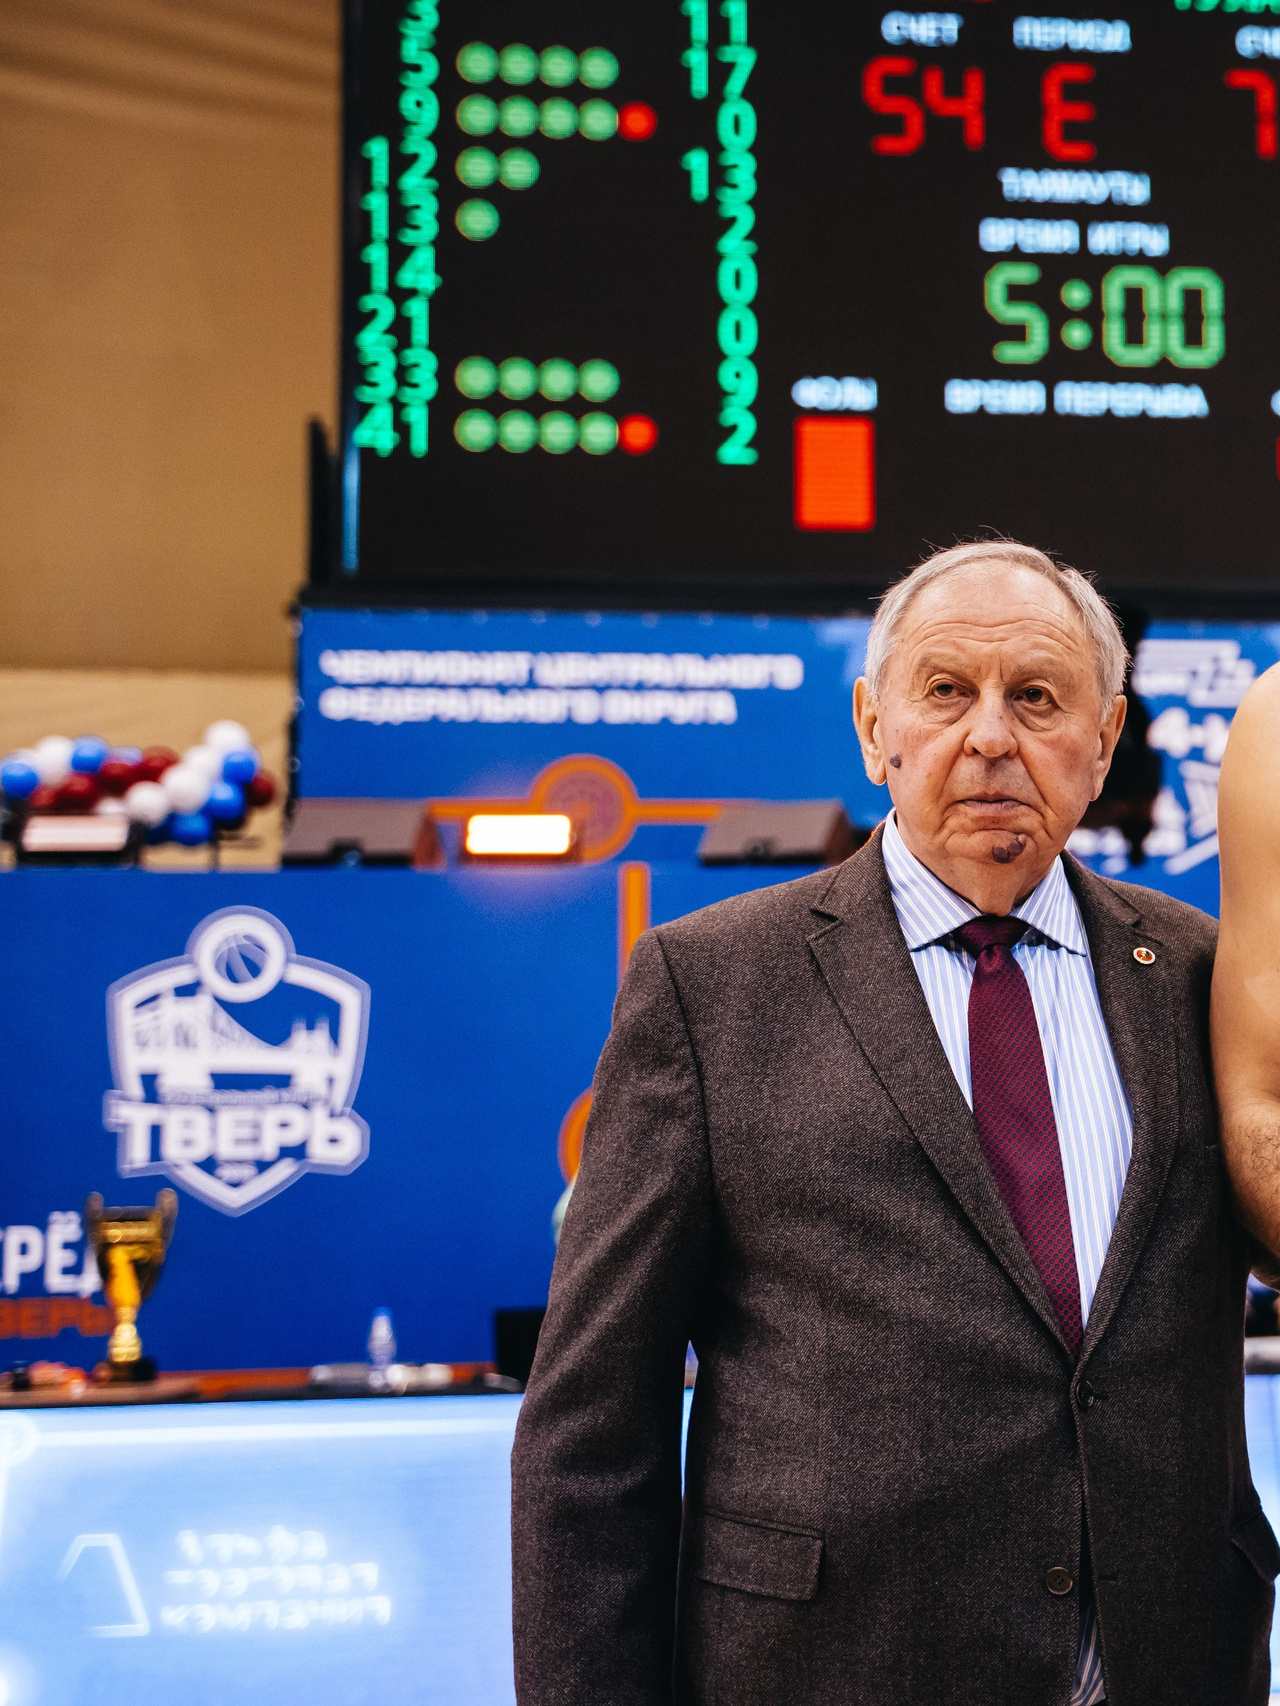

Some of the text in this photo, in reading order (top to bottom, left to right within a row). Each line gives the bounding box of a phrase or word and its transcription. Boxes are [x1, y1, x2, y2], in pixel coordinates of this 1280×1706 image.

[399, 34, 440, 88] 5
[680, 46, 757, 99] 17
[398, 86, 440, 139] 9
[716, 97, 757, 152] 0
[863, 55, 985, 156] 54
[361, 135, 438, 190] 12
[680, 147, 757, 203] 13
[360, 188, 439, 244] 13
[716, 200, 757, 256] 2
[360, 243, 443, 298] 14
[717, 253, 758, 307] 0
[355, 294, 429, 348] 21
[717, 304, 758, 359] 0
[984, 261, 1225, 369] 5:00
[354, 347, 439, 404] 33
[717, 356, 758, 410] 9
[352, 400, 429, 458] 41
[716, 407, 758, 465] 2
[115, 1101, 364, 1166] ТВЕРЬ
